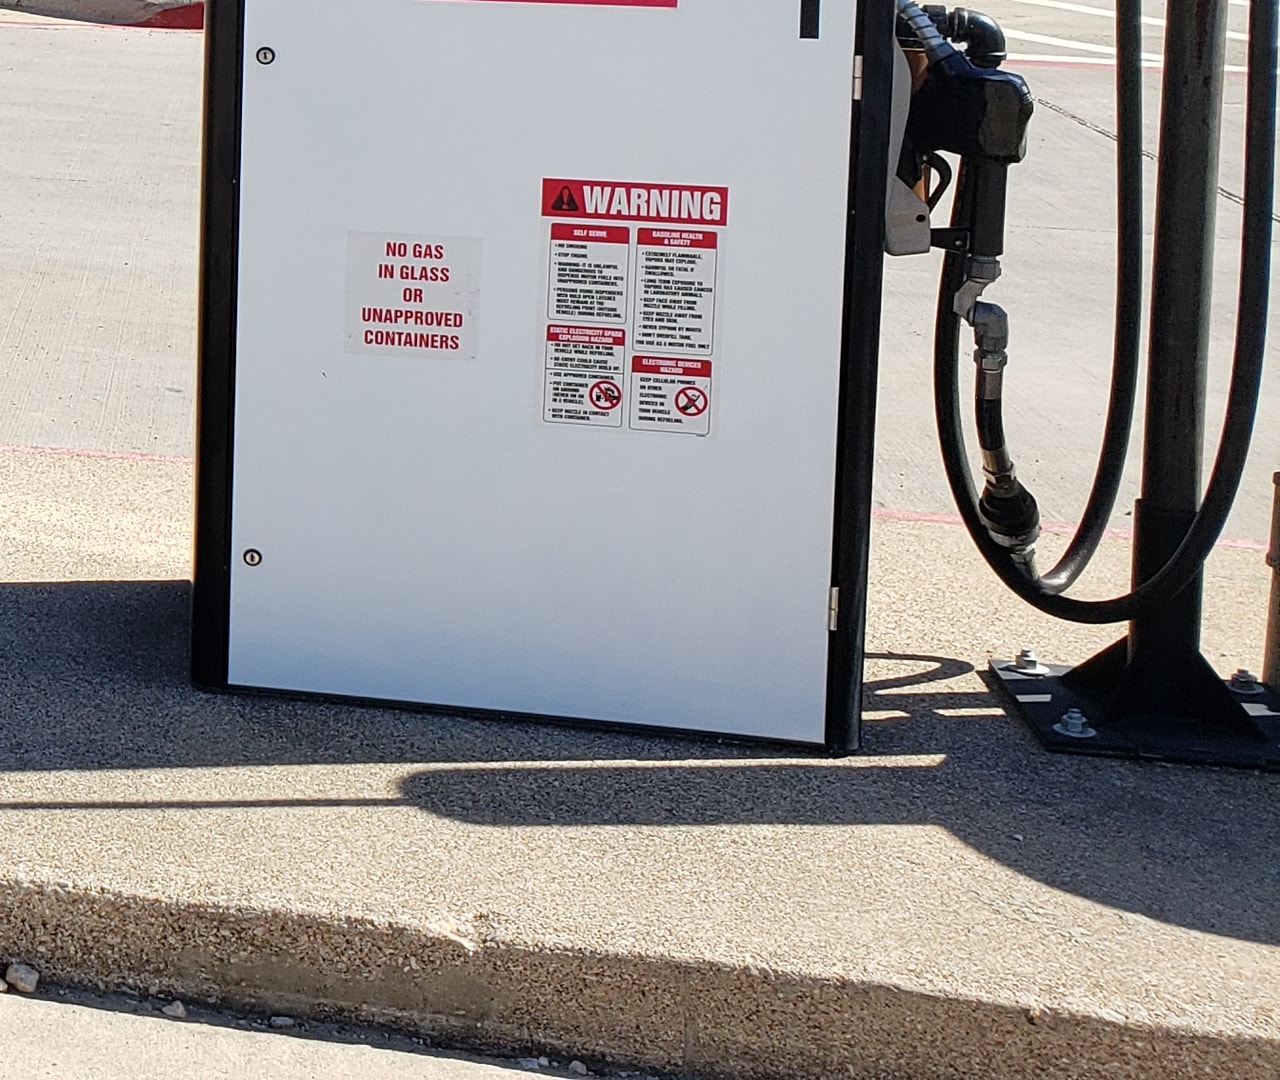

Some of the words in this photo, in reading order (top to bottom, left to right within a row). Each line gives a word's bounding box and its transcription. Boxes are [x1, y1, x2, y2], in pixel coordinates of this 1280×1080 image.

[582, 186, 722, 220] WARNING
[386, 242, 408, 258] NO
[412, 243, 444, 259] GAS
[378, 264, 394, 279] IN
[399, 265, 450, 282] GLASS
[403, 288, 423, 302] OR
[362, 307, 463, 328] UNAPPROVED
[364, 330, 460, 350] CONTAINERS
